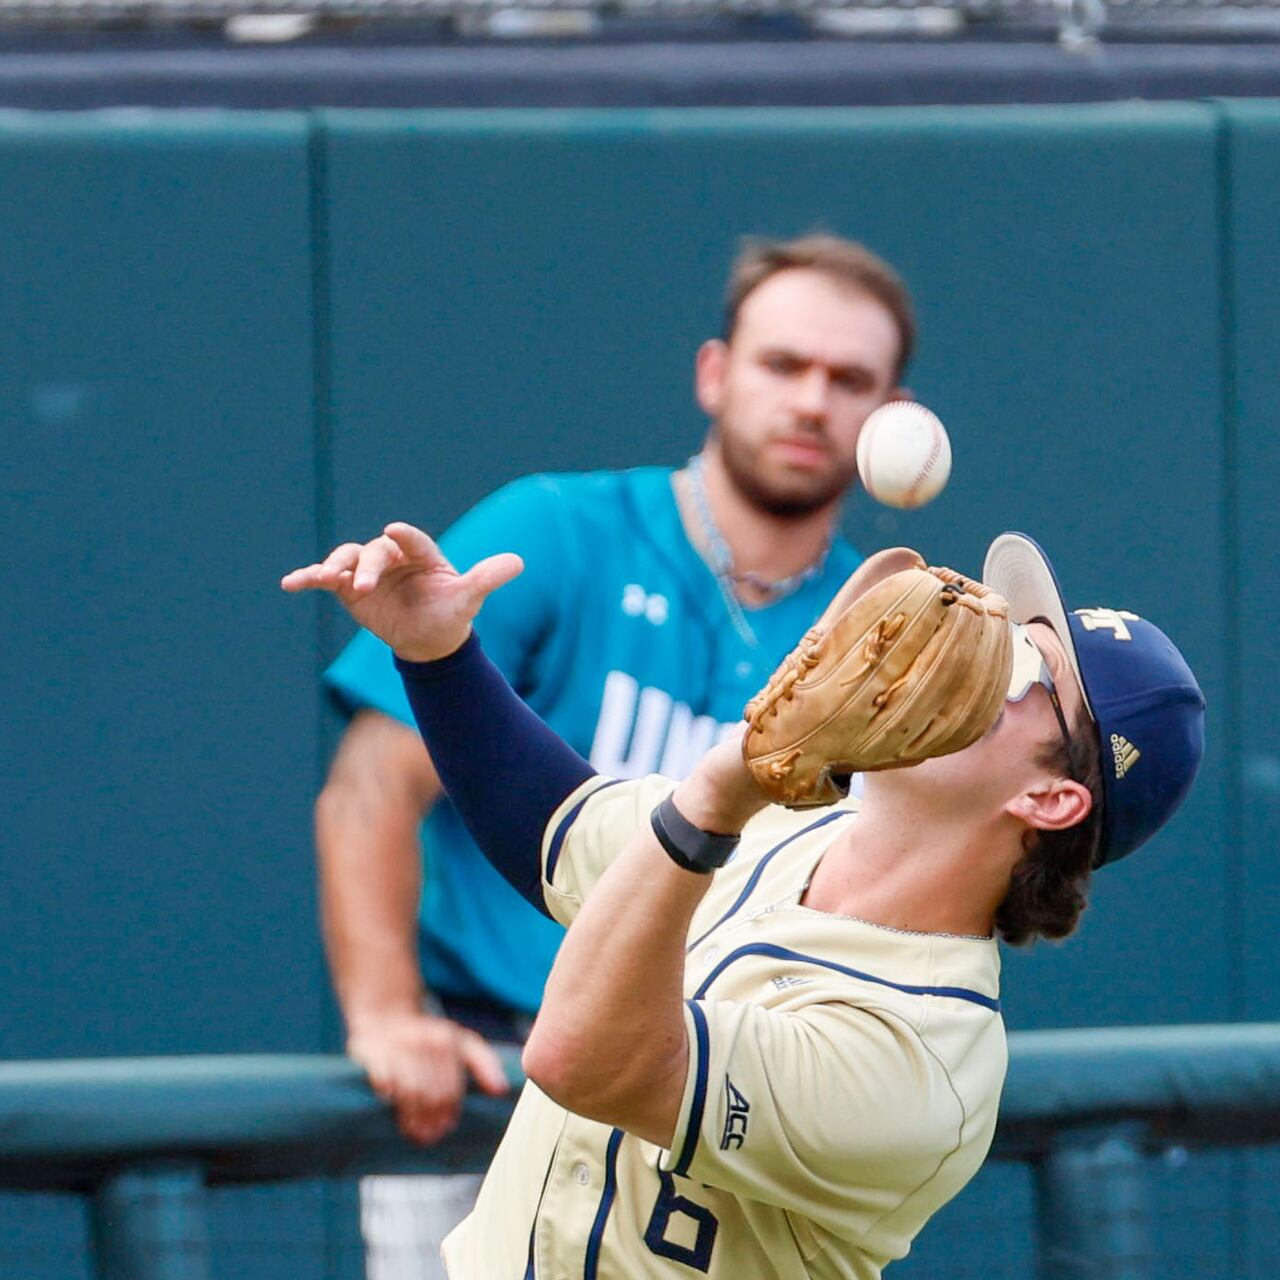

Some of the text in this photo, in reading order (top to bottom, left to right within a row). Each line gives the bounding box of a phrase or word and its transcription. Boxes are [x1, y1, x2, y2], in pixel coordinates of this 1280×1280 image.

[1110, 733, 1125, 779] adidas
[721, 1075, 750, 1150] ACC
[643, 1150, 719, 1274] 6
